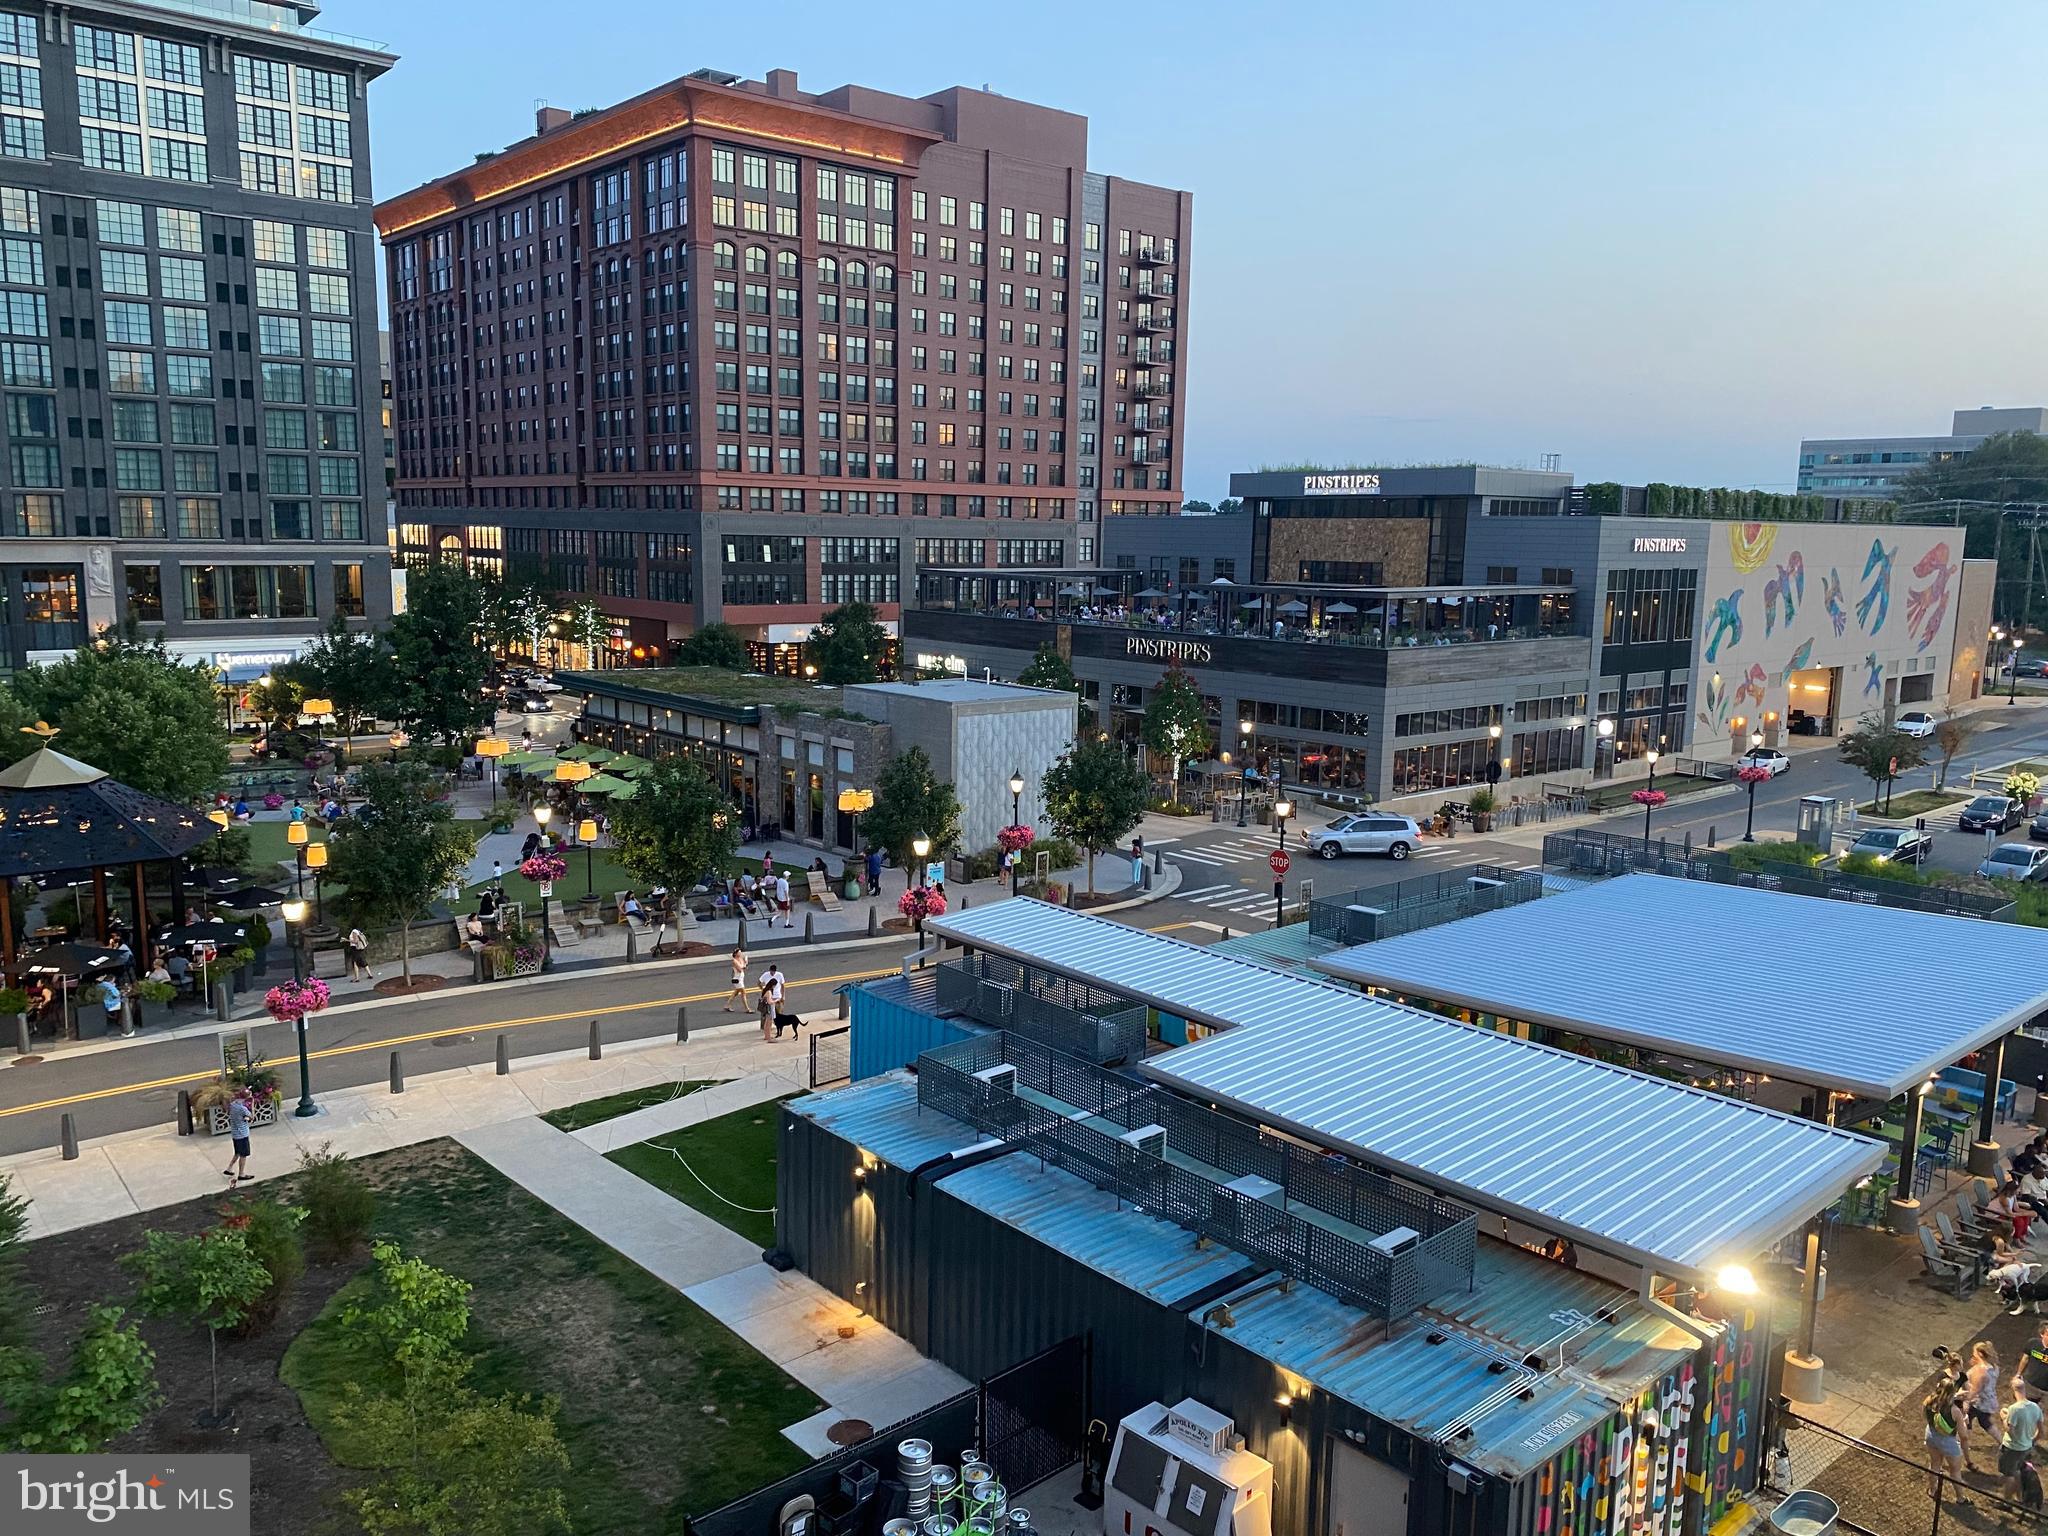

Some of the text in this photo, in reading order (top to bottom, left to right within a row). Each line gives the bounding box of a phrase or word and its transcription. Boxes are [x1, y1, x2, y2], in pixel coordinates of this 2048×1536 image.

[1304, 475, 1380, 488] PINSTRIPES
[1634, 538, 1686, 552] PINSTRIPES
[1127, 637, 1211, 662] PINSTRIPES
[1270, 857, 1289, 867] STOP
